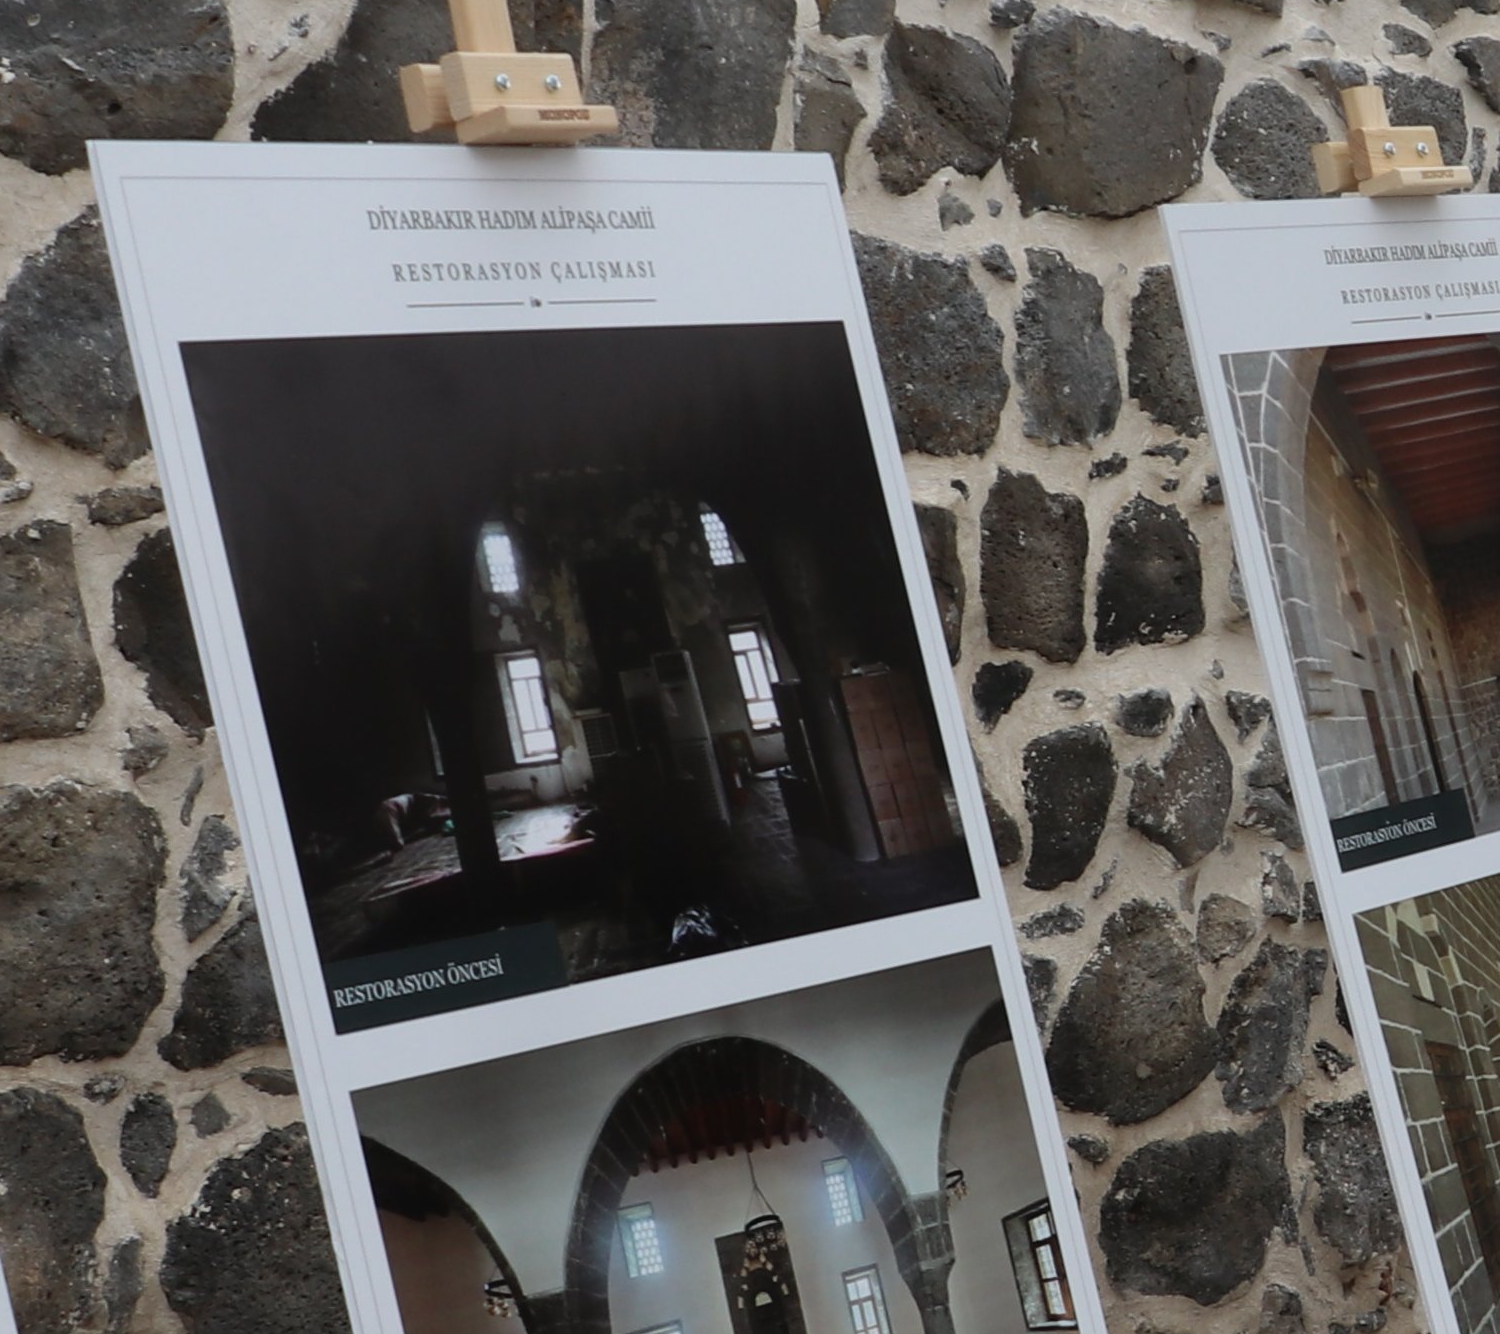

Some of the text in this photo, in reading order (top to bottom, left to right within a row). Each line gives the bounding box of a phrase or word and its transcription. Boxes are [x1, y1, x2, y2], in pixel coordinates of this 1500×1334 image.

[366, 205, 657, 234] DİYARBAKIR HADIM ALİPAŞA CAMİİ
[1324, 245, 1389, 266] DİYARBAKIR
[1390, 244, 1425, 262] HADIM
[1427, 239, 1467, 262] ALİPAŞA
[392, 260, 656, 284] RESTORASYON ÇALIŞMASI
[1341, 280, 1500, 305] RESTORASYON ÇALIŞMASI
[1336, 812, 1437, 853] RESTORASYON ÖNCESİ
[333, 952, 504, 1008] RESTORASYON ÖNCESİ
